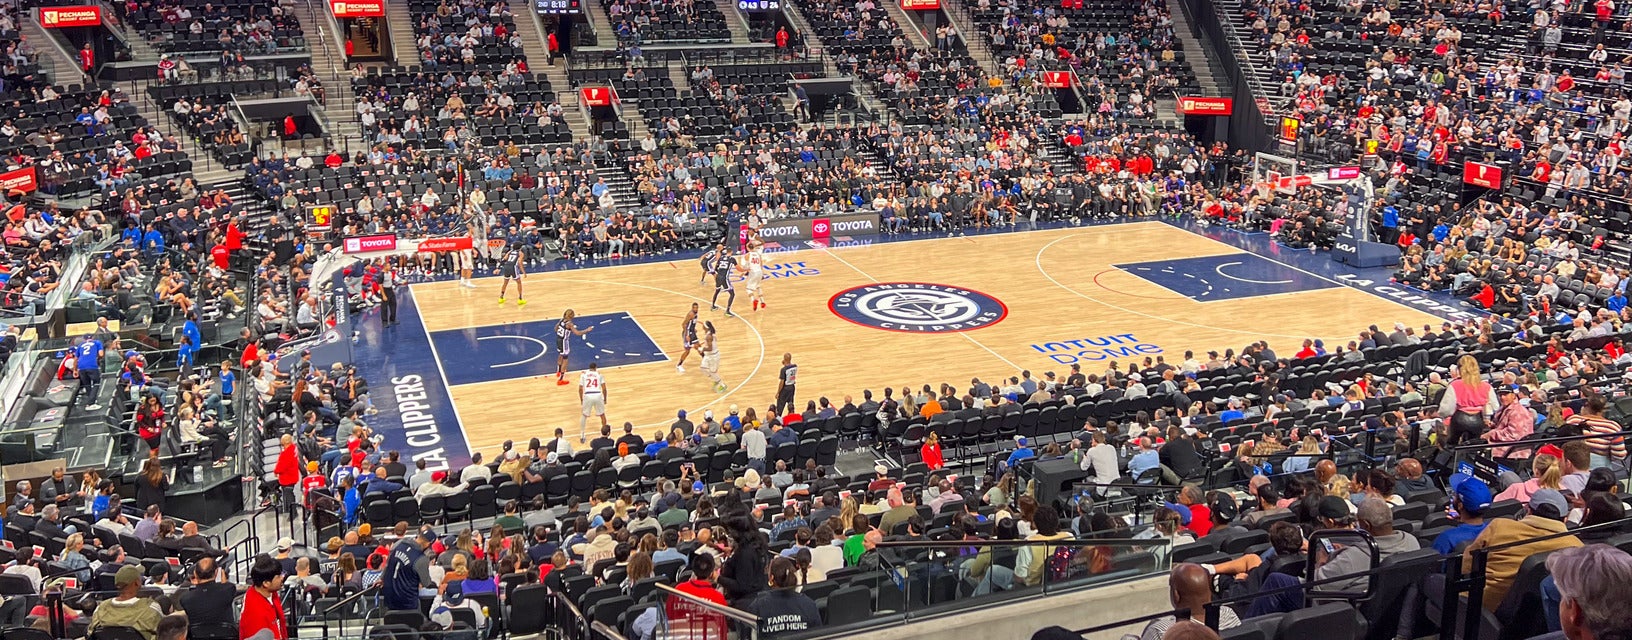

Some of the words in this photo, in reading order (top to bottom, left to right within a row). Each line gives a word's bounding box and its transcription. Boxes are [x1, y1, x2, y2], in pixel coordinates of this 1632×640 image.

[59, 11, 97, 19] PECHANGA
[592, 89, 598, 99] P
[1479, 166, 1486, 178] P
[759, 225, 800, 238] TOYOTA
[832, 220, 873, 232] TOYOTA
[362, 240, 392, 248] TOYOTA
[719, 261, 729, 269] 25
[751, 257, 760, 265] 40
[1335, 273, 1374, 287] LA
[837, 292, 857, 308] LOS
[864, 283, 971, 296] ANGELES
[879, 310, 998, 331] CLIPPERS
[83, 346, 91, 355] 2
[586, 378, 598, 388] 24
[391, 374, 441, 447] CLIPPERS
[411, 447, 450, 473] LA
[1461, 466, 1473, 477] 26
[393, 562, 400, 579] 1
[767, 615, 801, 625] FANDOM
[786, 622, 808, 630] HERE
